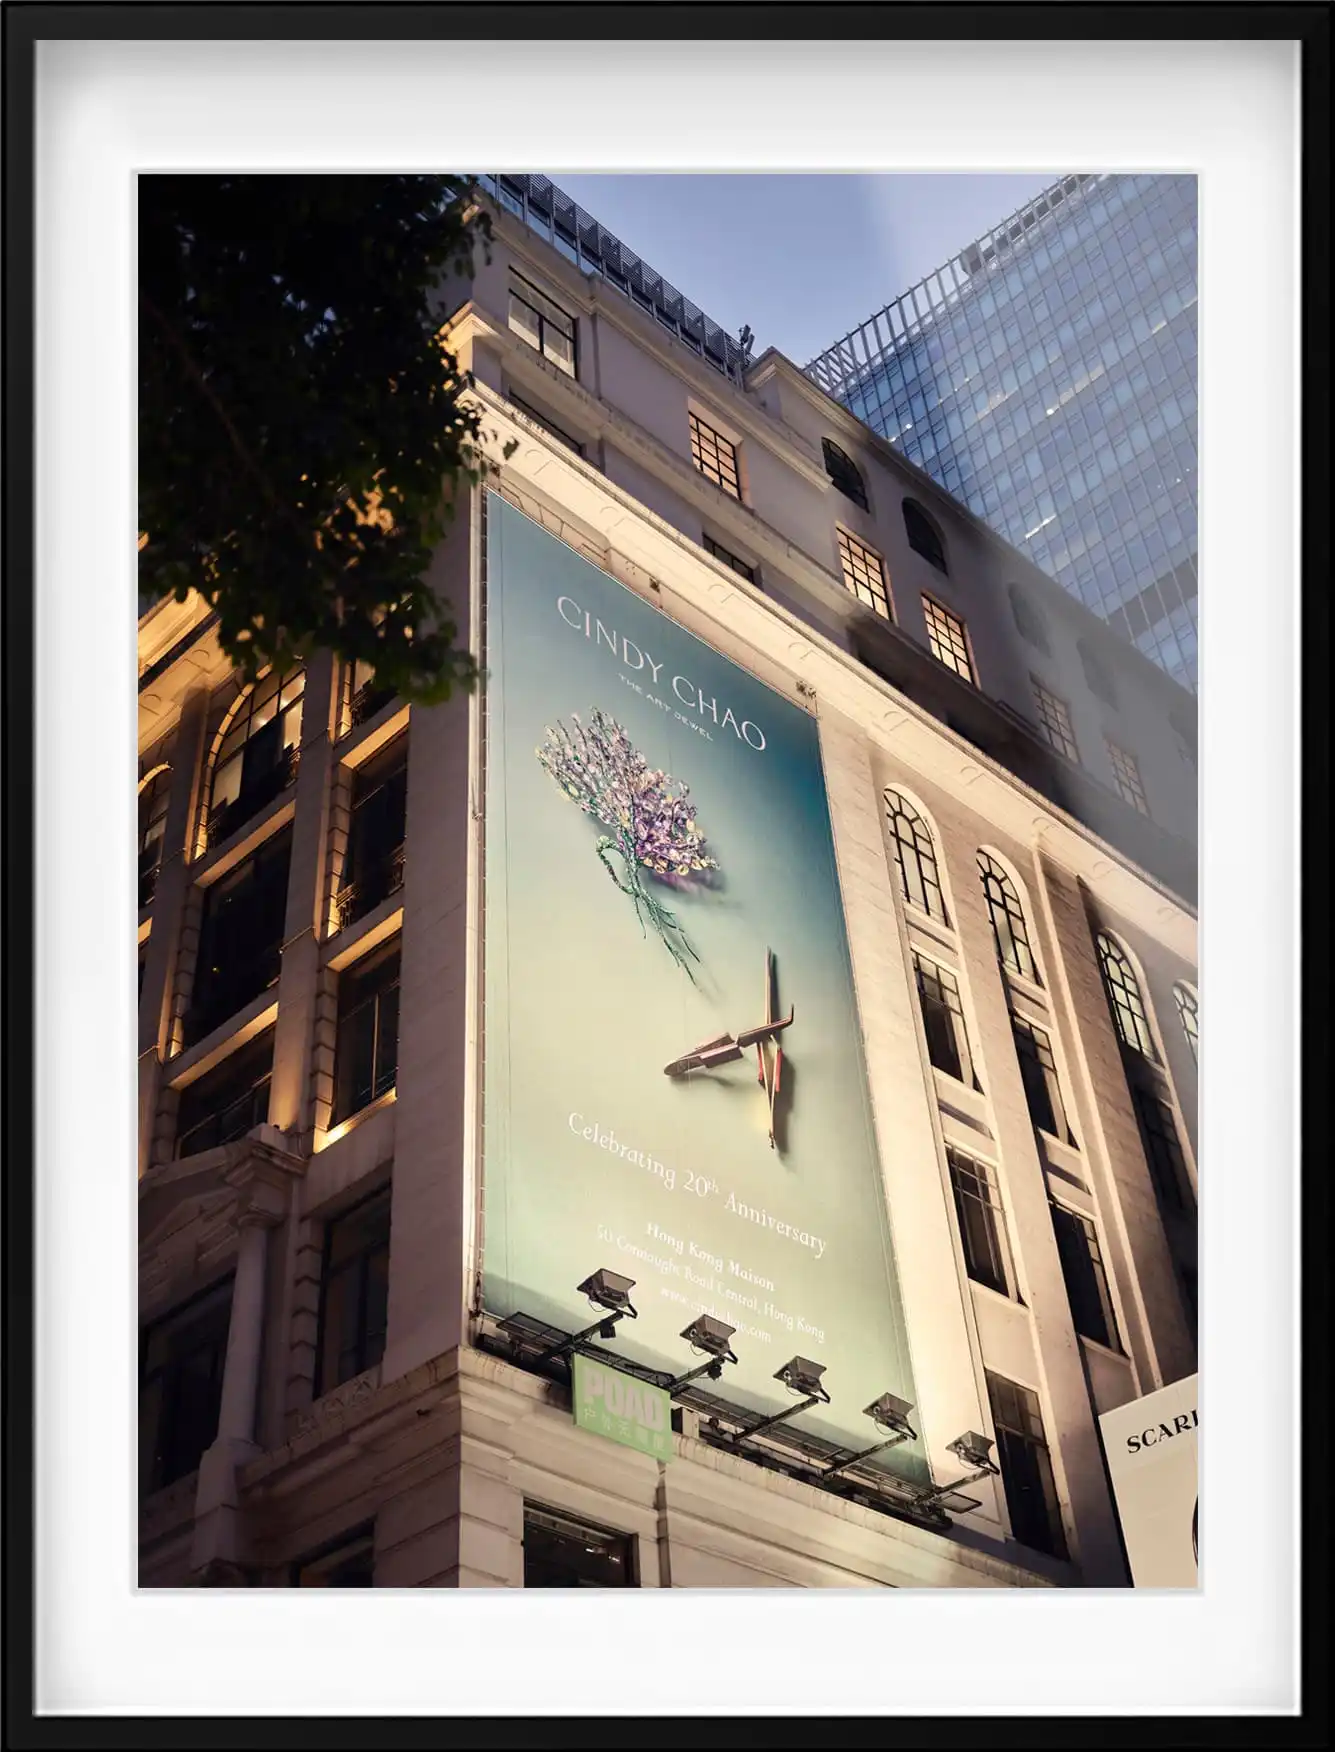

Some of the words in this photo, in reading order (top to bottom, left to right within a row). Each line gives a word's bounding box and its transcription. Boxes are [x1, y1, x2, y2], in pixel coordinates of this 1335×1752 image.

[557, 596, 664, 683] CINDY
[671, 675, 766, 751] CHAO
[617, 672, 644, 694] THE
[646, 693, 672, 713] ART
[673, 710, 714, 741] JEWEL
[568, 1112, 677, 1190] Celebrating
[683, 1169, 720, 1197] 20th
[724, 1192, 827, 1259] Anniversary
[616, 1233, 680, 1275] Connaught
[684, 1267, 715, 1292] Road
[717, 1280, 762, 1315] Central,
[764, 1303, 794, 1329] Hong
[796, 1316, 826, 1343] Kong
[646, 1222, 685, 1254] Hong
[689, 1241, 725, 1273] Kong
[728, 1259, 776, 1292] Maison
[583, 1365, 665, 1432] POAD
